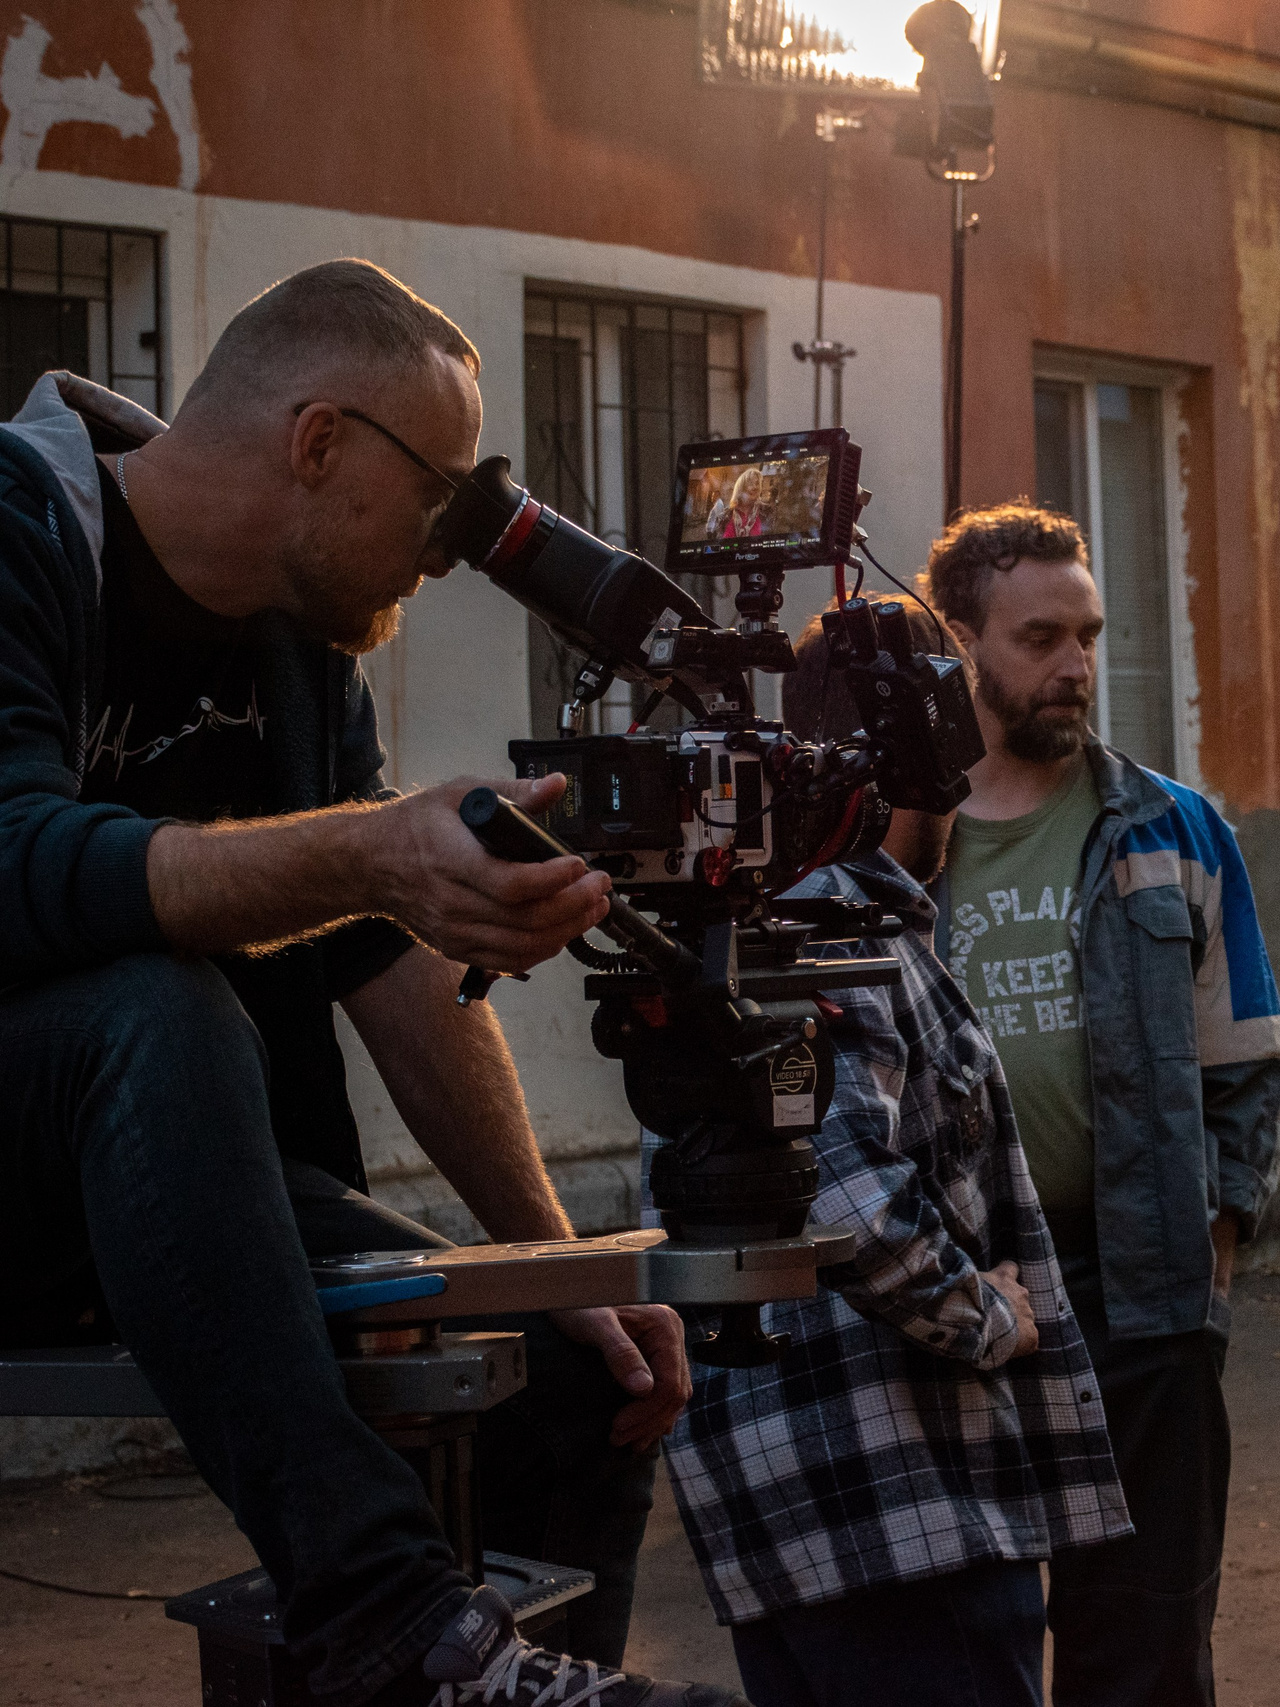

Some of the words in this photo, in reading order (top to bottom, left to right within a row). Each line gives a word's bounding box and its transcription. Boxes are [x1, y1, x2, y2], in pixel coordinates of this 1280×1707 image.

[876, 798, 891, 814] 35
[949, 903, 989, 997] ASS
[982, 950, 1074, 998] KEEP
[974, 1003, 1027, 1038] HE
[1034, 995, 1084, 1032] BE
[775, 1071, 795, 1081] VIDEO
